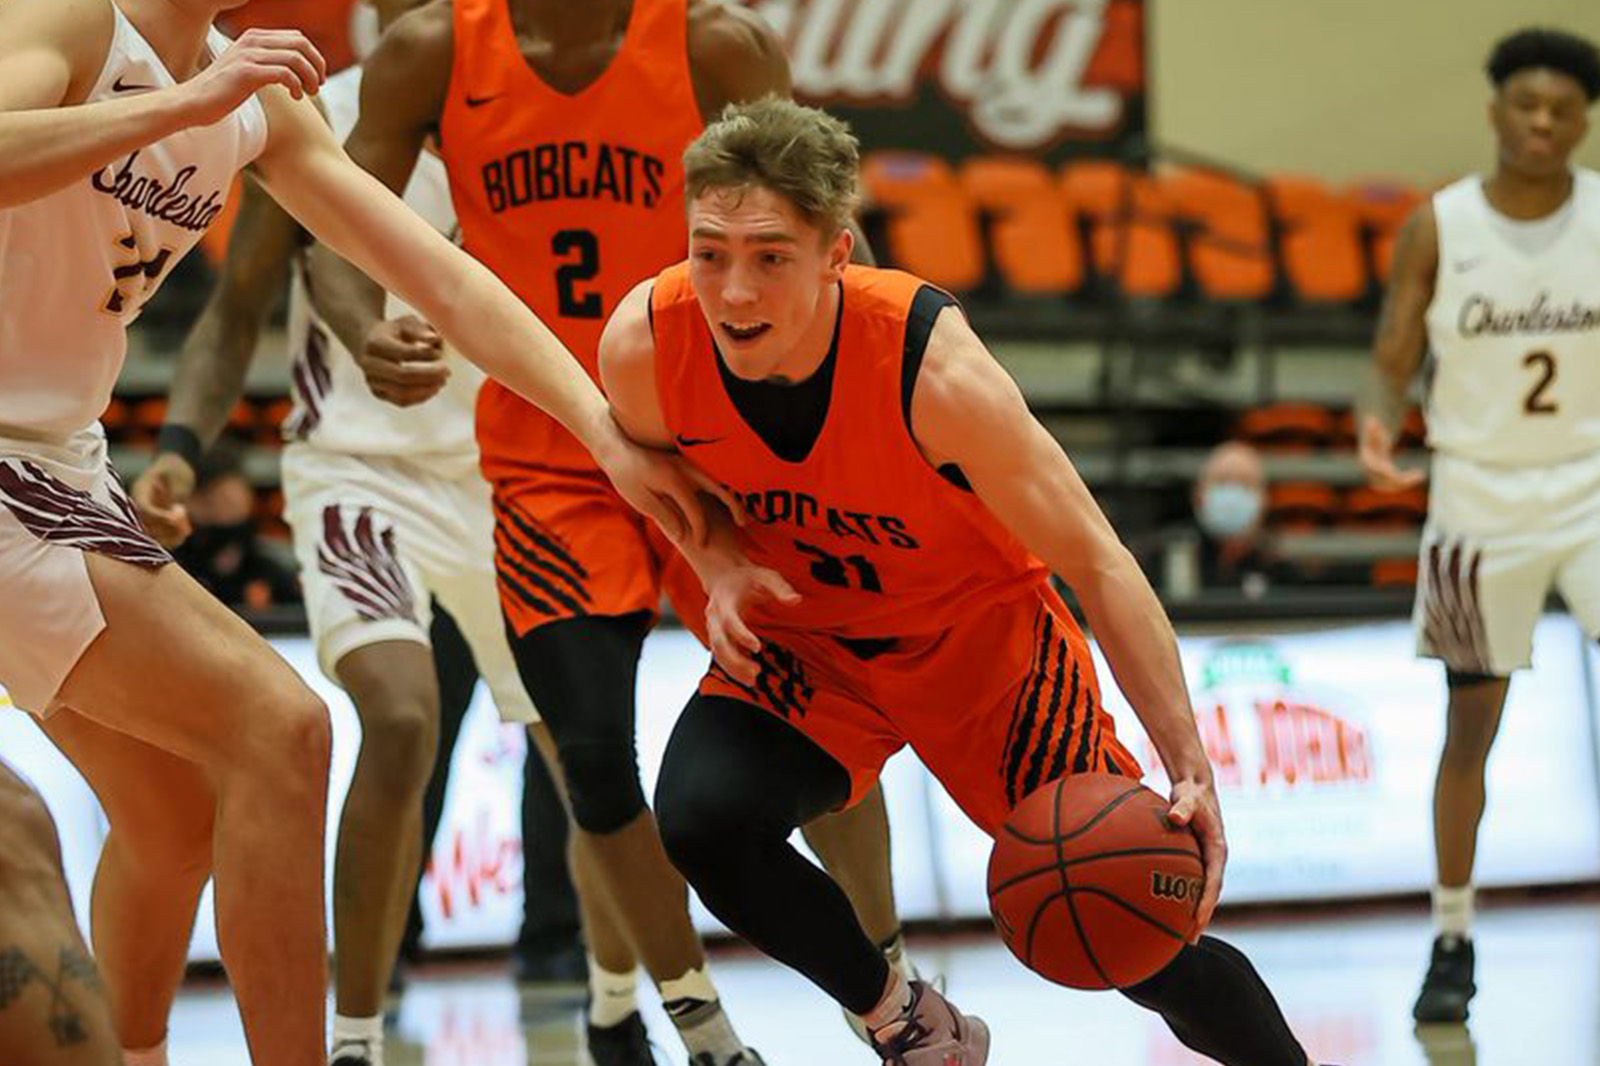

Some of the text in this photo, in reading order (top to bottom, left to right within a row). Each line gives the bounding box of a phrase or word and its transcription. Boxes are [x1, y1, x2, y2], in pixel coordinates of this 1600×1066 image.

[482, 141, 665, 214] BOBCATS
[552, 229, 602, 319] 2
[1522, 349, 1558, 416] 2
